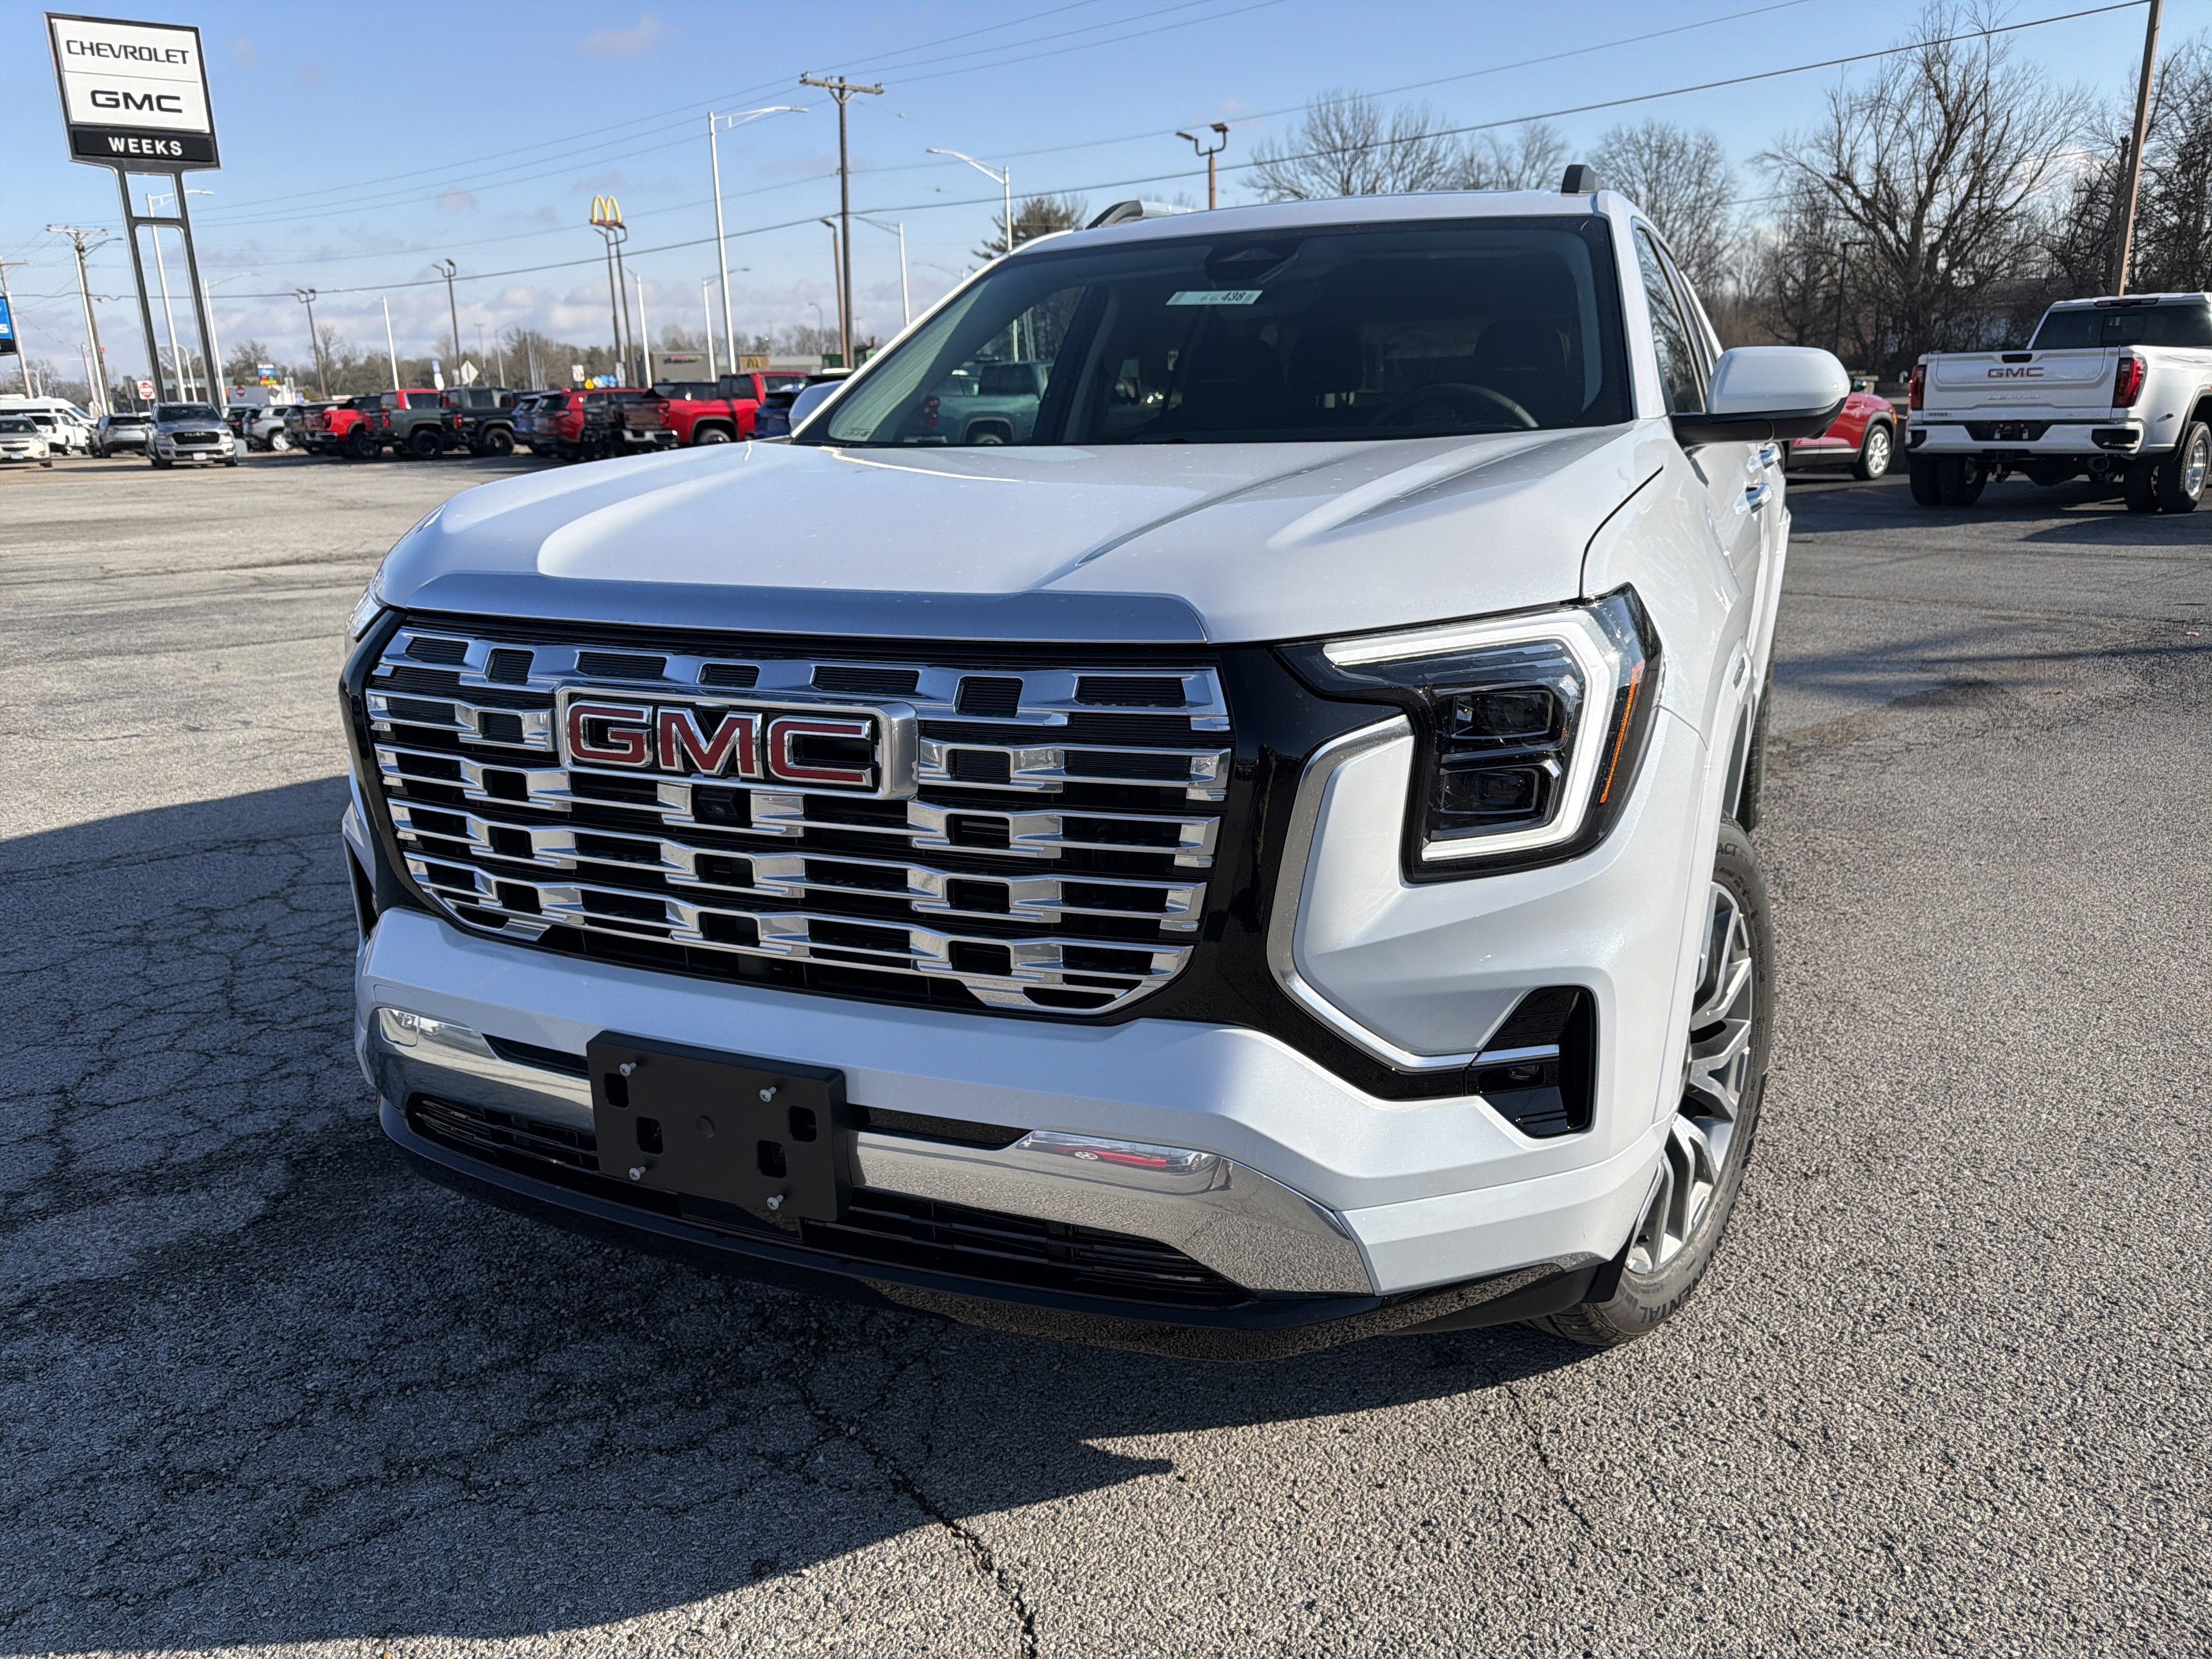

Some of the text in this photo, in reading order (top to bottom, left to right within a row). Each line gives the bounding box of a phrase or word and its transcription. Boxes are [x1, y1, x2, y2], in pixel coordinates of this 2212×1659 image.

[66, 40, 189, 65] CHEVROLET
[90, 89, 183, 114] GMC
[108, 137, 183, 156] WEEKS
[1987, 366, 2044, 378] GMC
[567, 699, 873, 788] GMC
